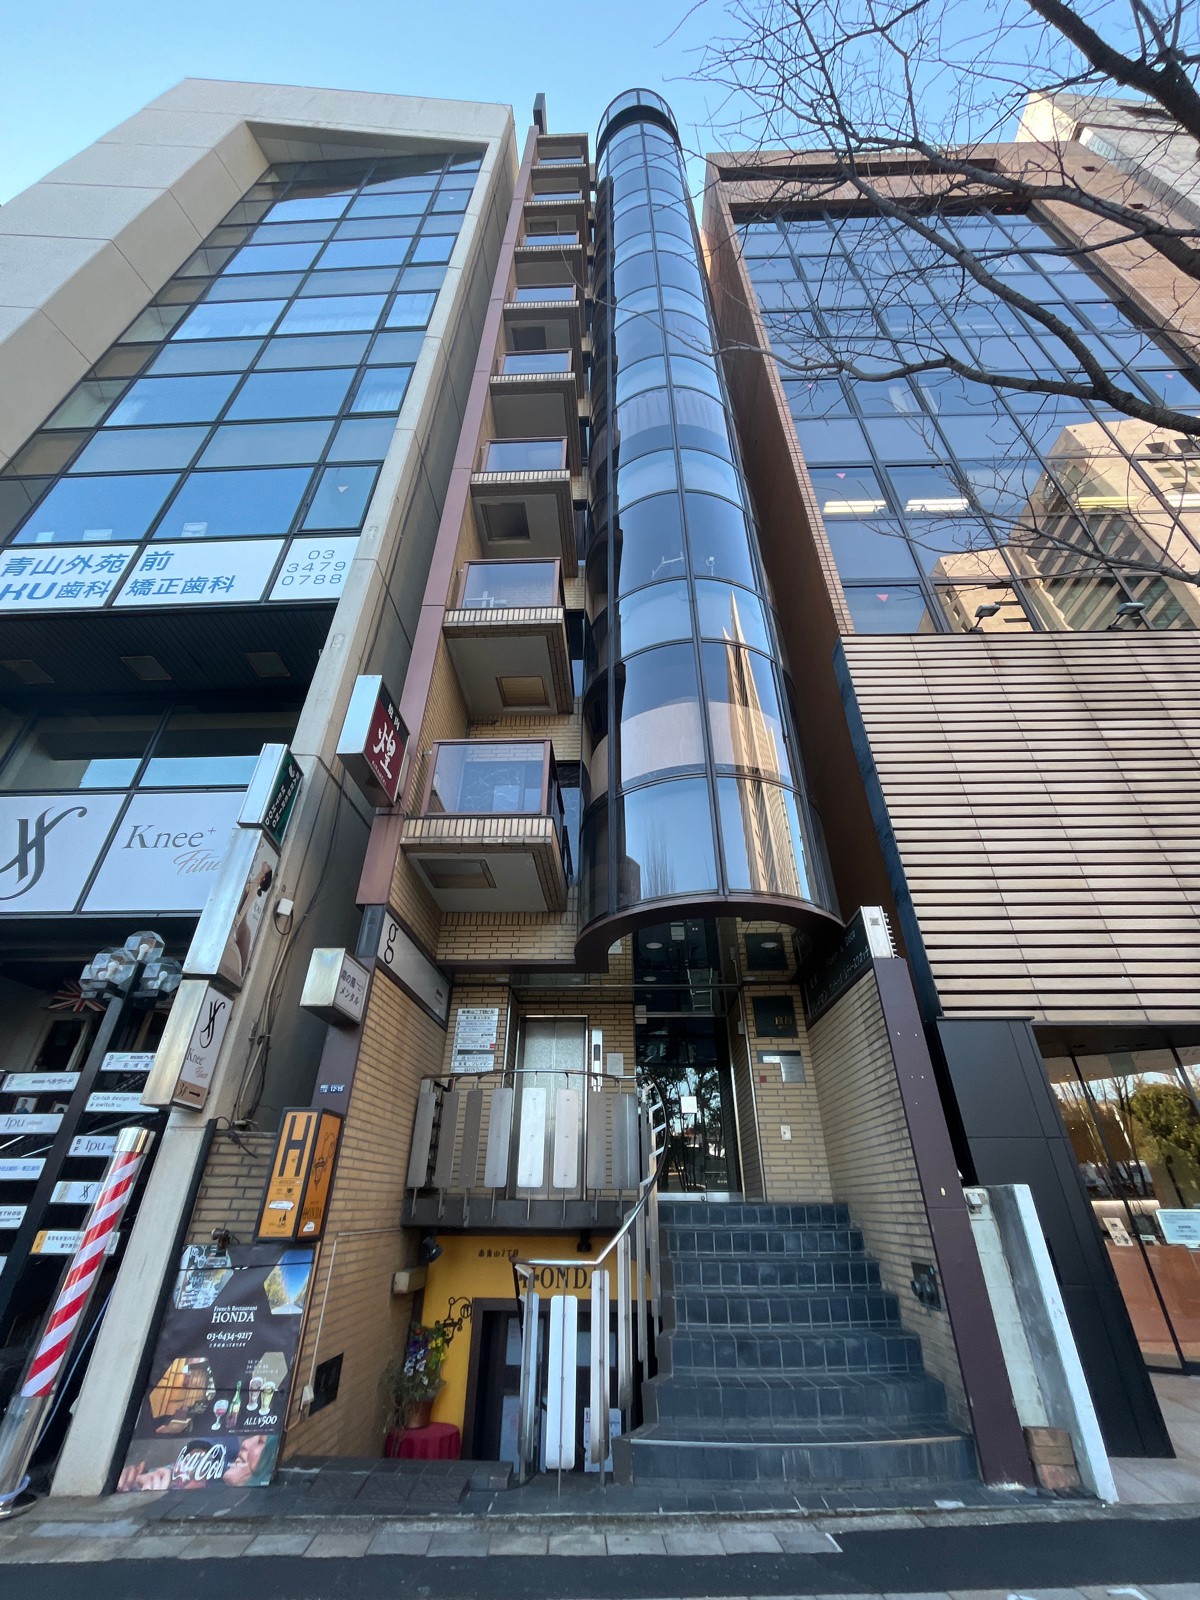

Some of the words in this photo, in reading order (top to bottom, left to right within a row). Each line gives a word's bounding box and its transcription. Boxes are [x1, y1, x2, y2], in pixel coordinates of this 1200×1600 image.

[308, 549, 335, 560] 03
[286, 561, 346, 573] 3479
[281, 573, 342, 586] 0788
[211, 1311, 255, 1323] HONDA
[206, 1331, 253, 1342] 03-6434-9217
